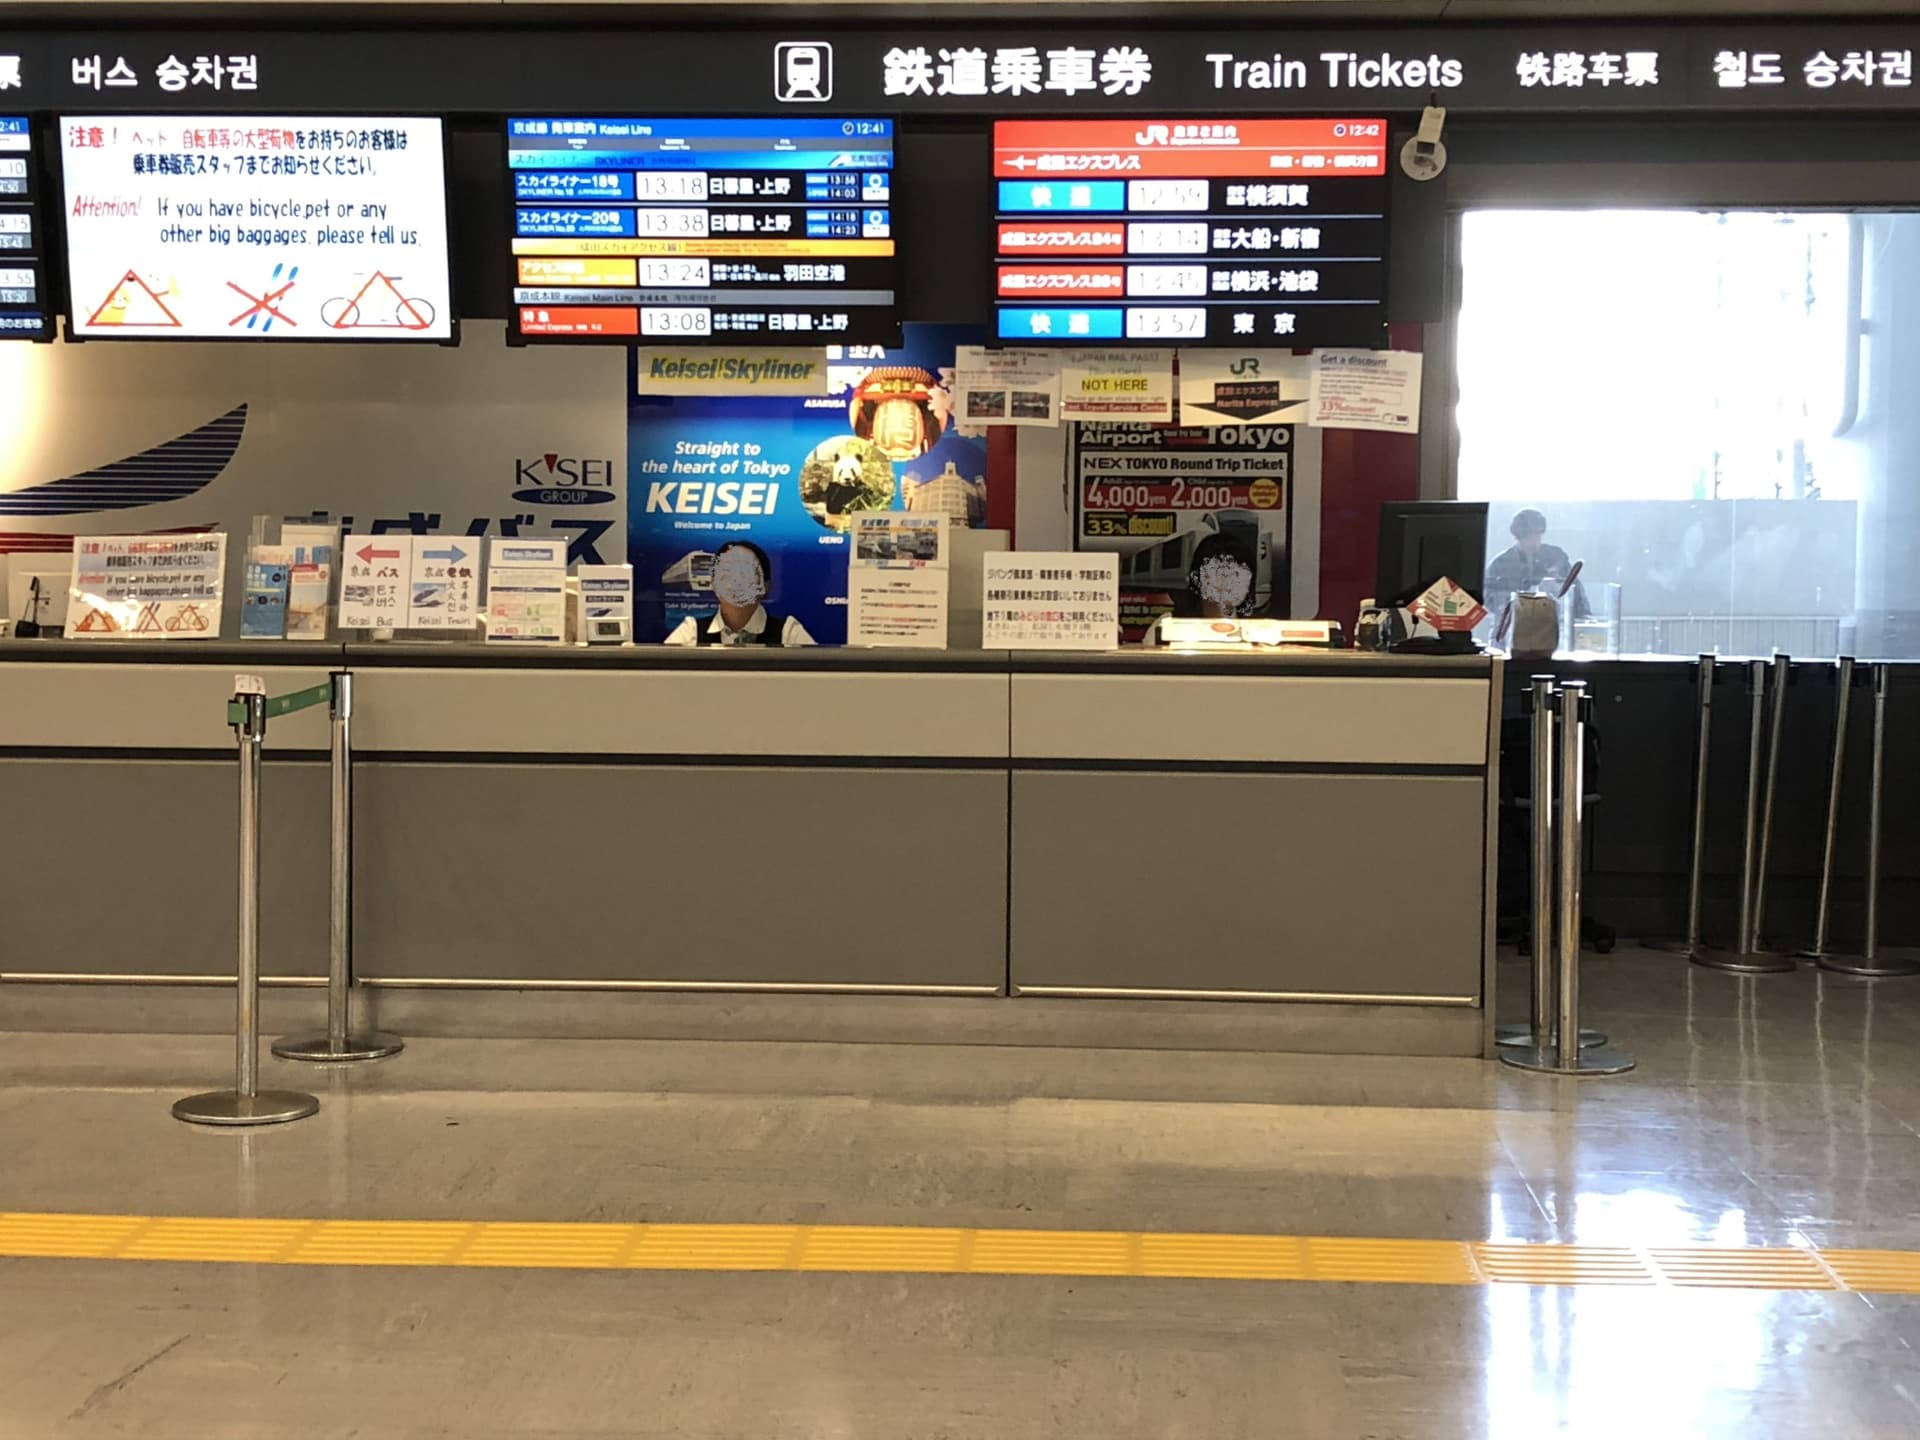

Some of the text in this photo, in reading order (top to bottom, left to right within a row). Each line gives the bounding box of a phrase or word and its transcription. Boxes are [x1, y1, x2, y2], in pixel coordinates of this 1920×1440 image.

[71, 55, 259, 91] 버스 승차권
[882, 47, 1152, 96] 鉄道乗車券
[1205, 53, 1464, 89] Train Tickets
[1516, 51, 1659, 87] 铁路车票
[1713, 50, 1912, 87] 철도 승차권
[857, 122, 885, 135] 12:41
[1135, 125, 1169, 146] JR
[1350, 124, 1380, 137] 12:42
[74, 195, 143, 217] Attention!
[160, 197, 173, 216] If
[178, 201, 206, 223] you
[210, 198, 246, 217] have
[337, 201, 355, 217] or
[360, 200, 389, 221] any
[161, 226, 203, 244] other
[209, 225, 232, 247] big
[317, 226, 365, 248] please
[370, 224, 396, 244] tell
[645, 263, 706, 282] 13:24
[783, 264, 847, 282] 羽田空港
[593, 292, 614, 303] Main
[615, 292, 634, 303] Line
[648, 312, 708, 331] 13:08
[1229, 358, 1260, 376] JR
[1320, 354, 1387, 371] Get a discount
[1081, 379, 1148, 391] NOT HERE
[1216, 399, 1278, 409] Narita Express
[1080, 421, 1152, 431] Narita
[1080, 430, 1162, 447] Airport
[1208, 424, 1290, 449] Tokyo
[675, 441, 761, 457] Straight to
[642, 460, 791, 479] the heart of Tokyo
[1126, 457, 1167, 470] TOKYO
[1171, 457, 1211, 470] Round
[1214, 457, 1239, 472] Trip
[1242, 458, 1284, 470] Ticket
[540, 492, 590, 504] GROUP
[645, 482, 780, 515] KEISEI
[1088, 477, 1149, 508] 4,000
[1171, 477, 1231, 508] 2,000
[674, 521, 751, 532] Welcome to Japan
[1087, 519, 1128, 535] 33%
[819, 537, 845, 545] UENO
